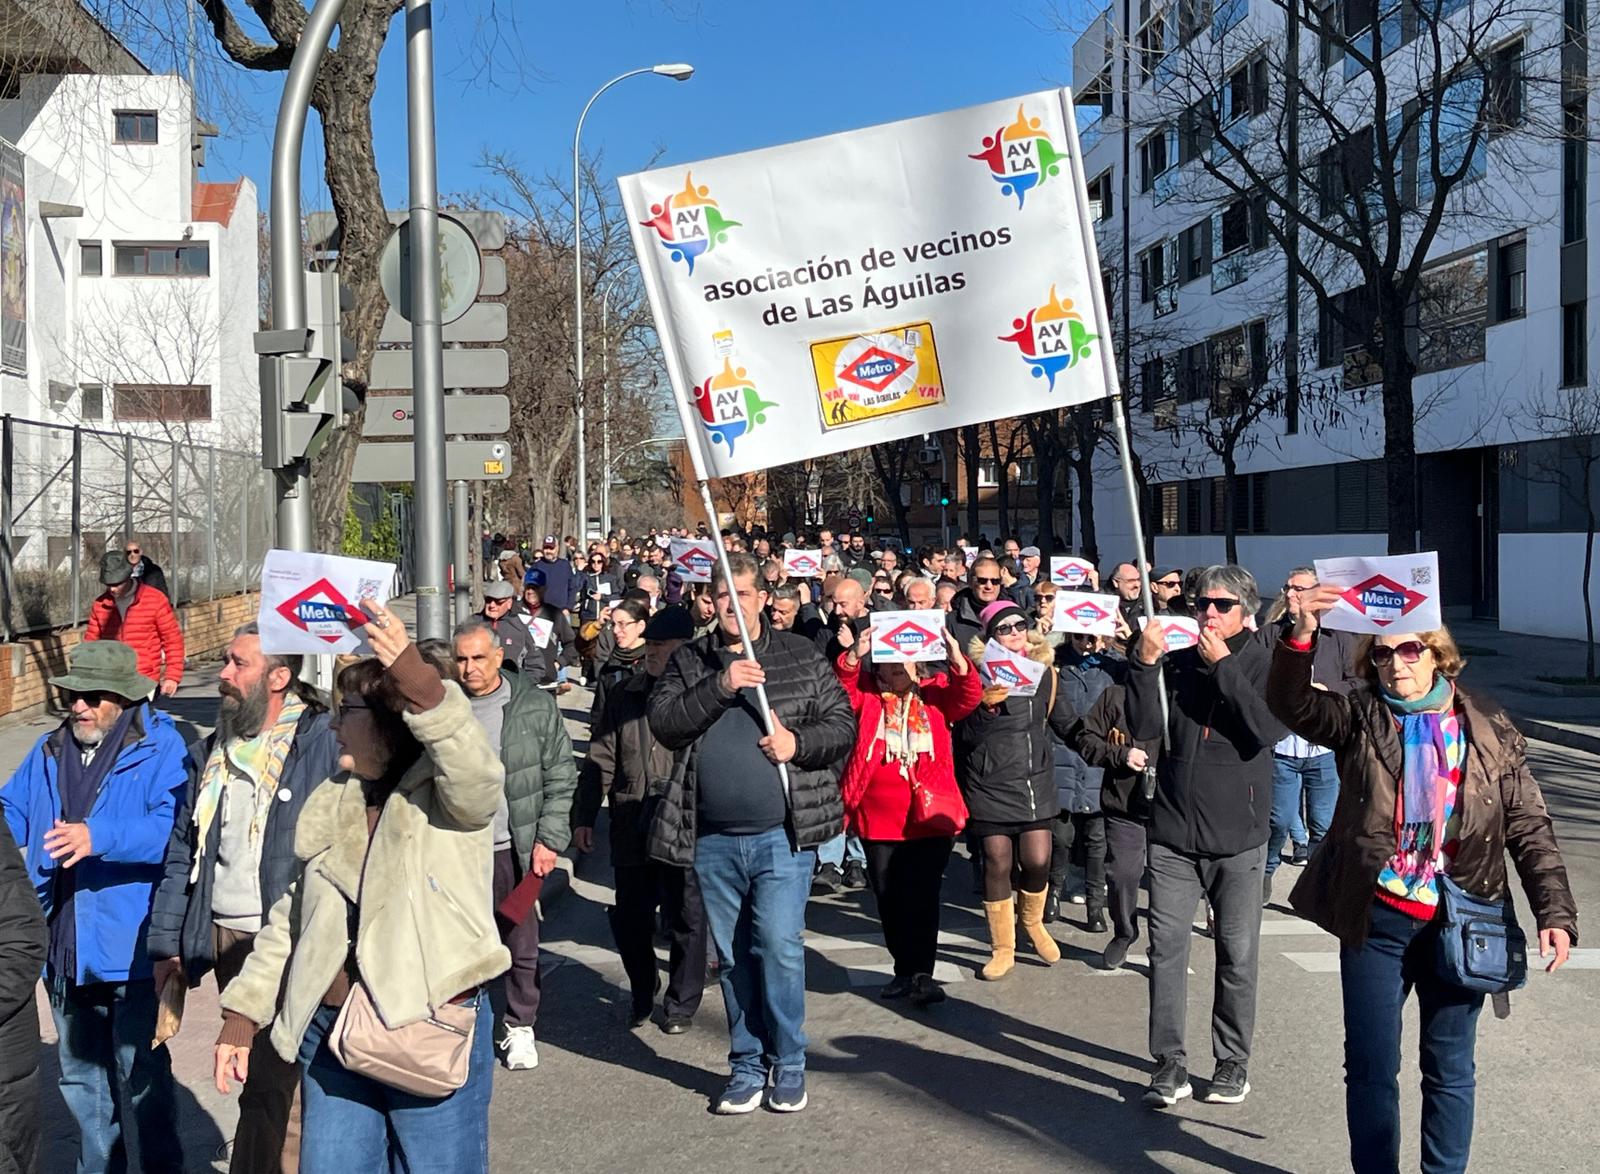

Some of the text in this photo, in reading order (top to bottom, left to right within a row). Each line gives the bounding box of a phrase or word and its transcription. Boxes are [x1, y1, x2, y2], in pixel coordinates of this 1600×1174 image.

[1007, 141, 1031, 158] AV
[1011, 158, 1035, 172] LA
[676, 208, 700, 225] AV
[680, 224, 704, 239] LA
[704, 227, 1012, 302] asociación de vecinos
[762, 272, 966, 326] de Las Águilas
[1038, 322, 1063, 339] AV
[1042, 339, 1067, 354] LA
[859, 363, 893, 378] Metro
[716, 390, 738, 407] AV
[919, 387, 939, 398] YA!
[864, 397, 876, 406] LAS
[720, 405, 744, 420] LA
[1364, 592, 1402, 605] Metro
[301, 604, 344, 619] Metro
[895, 634, 923, 643] Metro
[995, 667, 1018, 682] Metro
